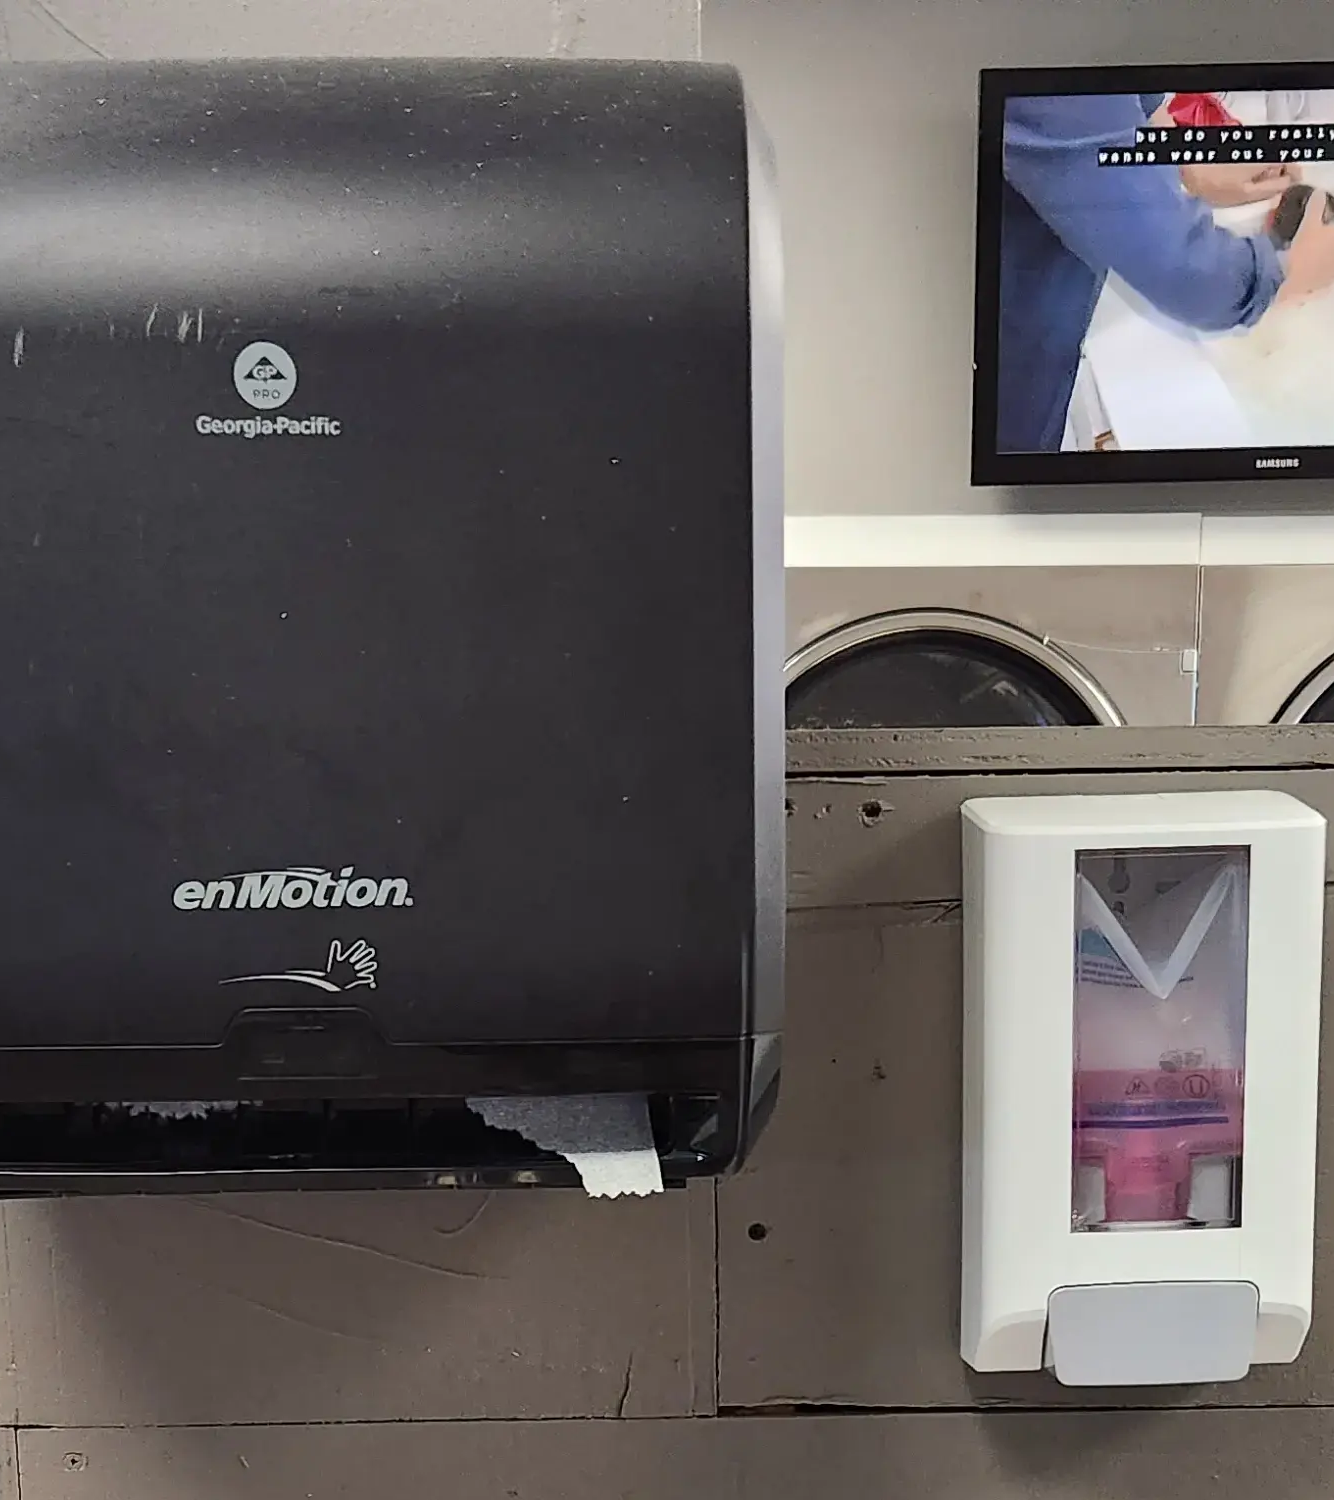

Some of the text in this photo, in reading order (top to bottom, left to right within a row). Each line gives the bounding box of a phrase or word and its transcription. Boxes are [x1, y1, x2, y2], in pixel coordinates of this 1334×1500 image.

[1135, 130, 1169, 143] but
[1184, 128, 1206, 142] do
[1220, 130, 1254, 144] you
[1098, 151, 1156, 164] wanna
[1231, 148, 1264, 161] out
[1280, 148, 1325, 161] your
[252, 388, 281, 400] PRO
[1255, 458, 1299, 469] SAMSUNG
